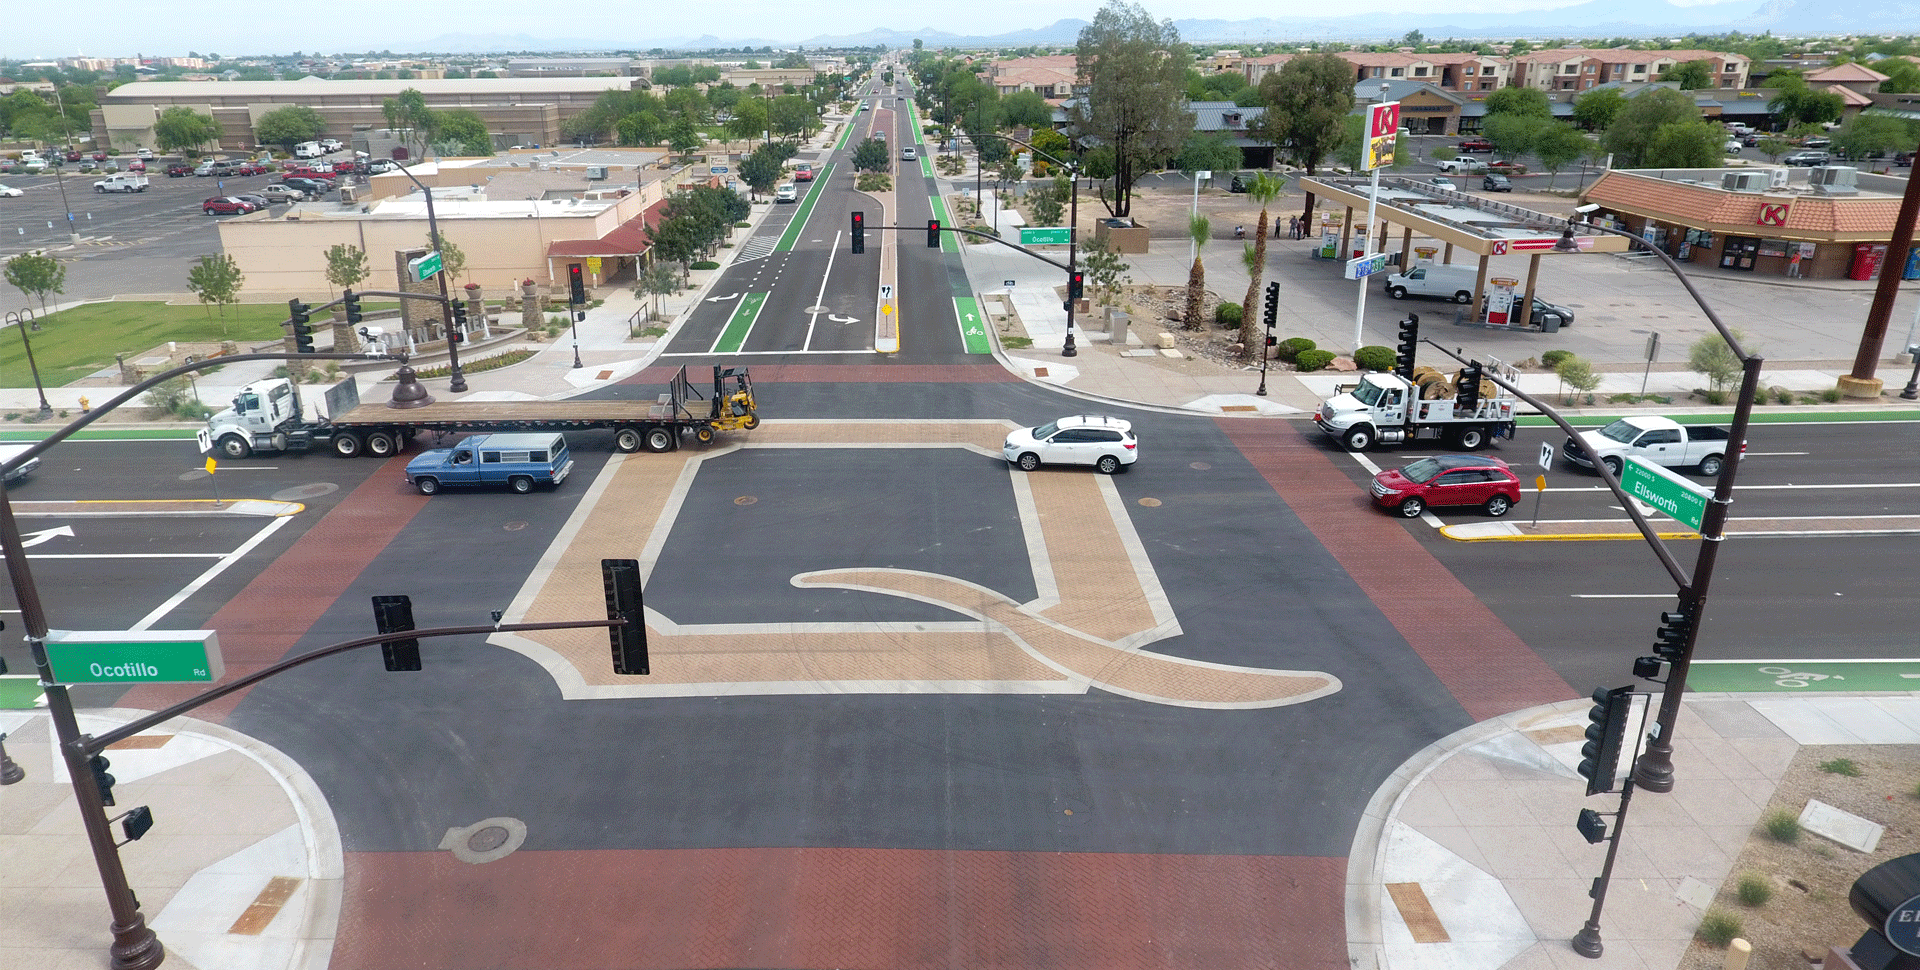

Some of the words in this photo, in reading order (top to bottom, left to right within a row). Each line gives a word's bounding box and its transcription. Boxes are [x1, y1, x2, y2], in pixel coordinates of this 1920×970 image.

[1379, 106, 1393, 135] K
[1760, 204, 1786, 226] K
[1493, 240, 1507, 254] K
[380, 327, 429, 348] OWN
[436, 315, 488, 340] CTE
[1635, 467, 1651, 480] 22000
[1634, 481, 1678, 514] Ellsworth
[1681, 491, 1699, 505] 20800
[1690, 516, 1699, 525] Rd
[90, 662, 158, 677] Ocotillo
[193, 668, 206, 677] Rd
